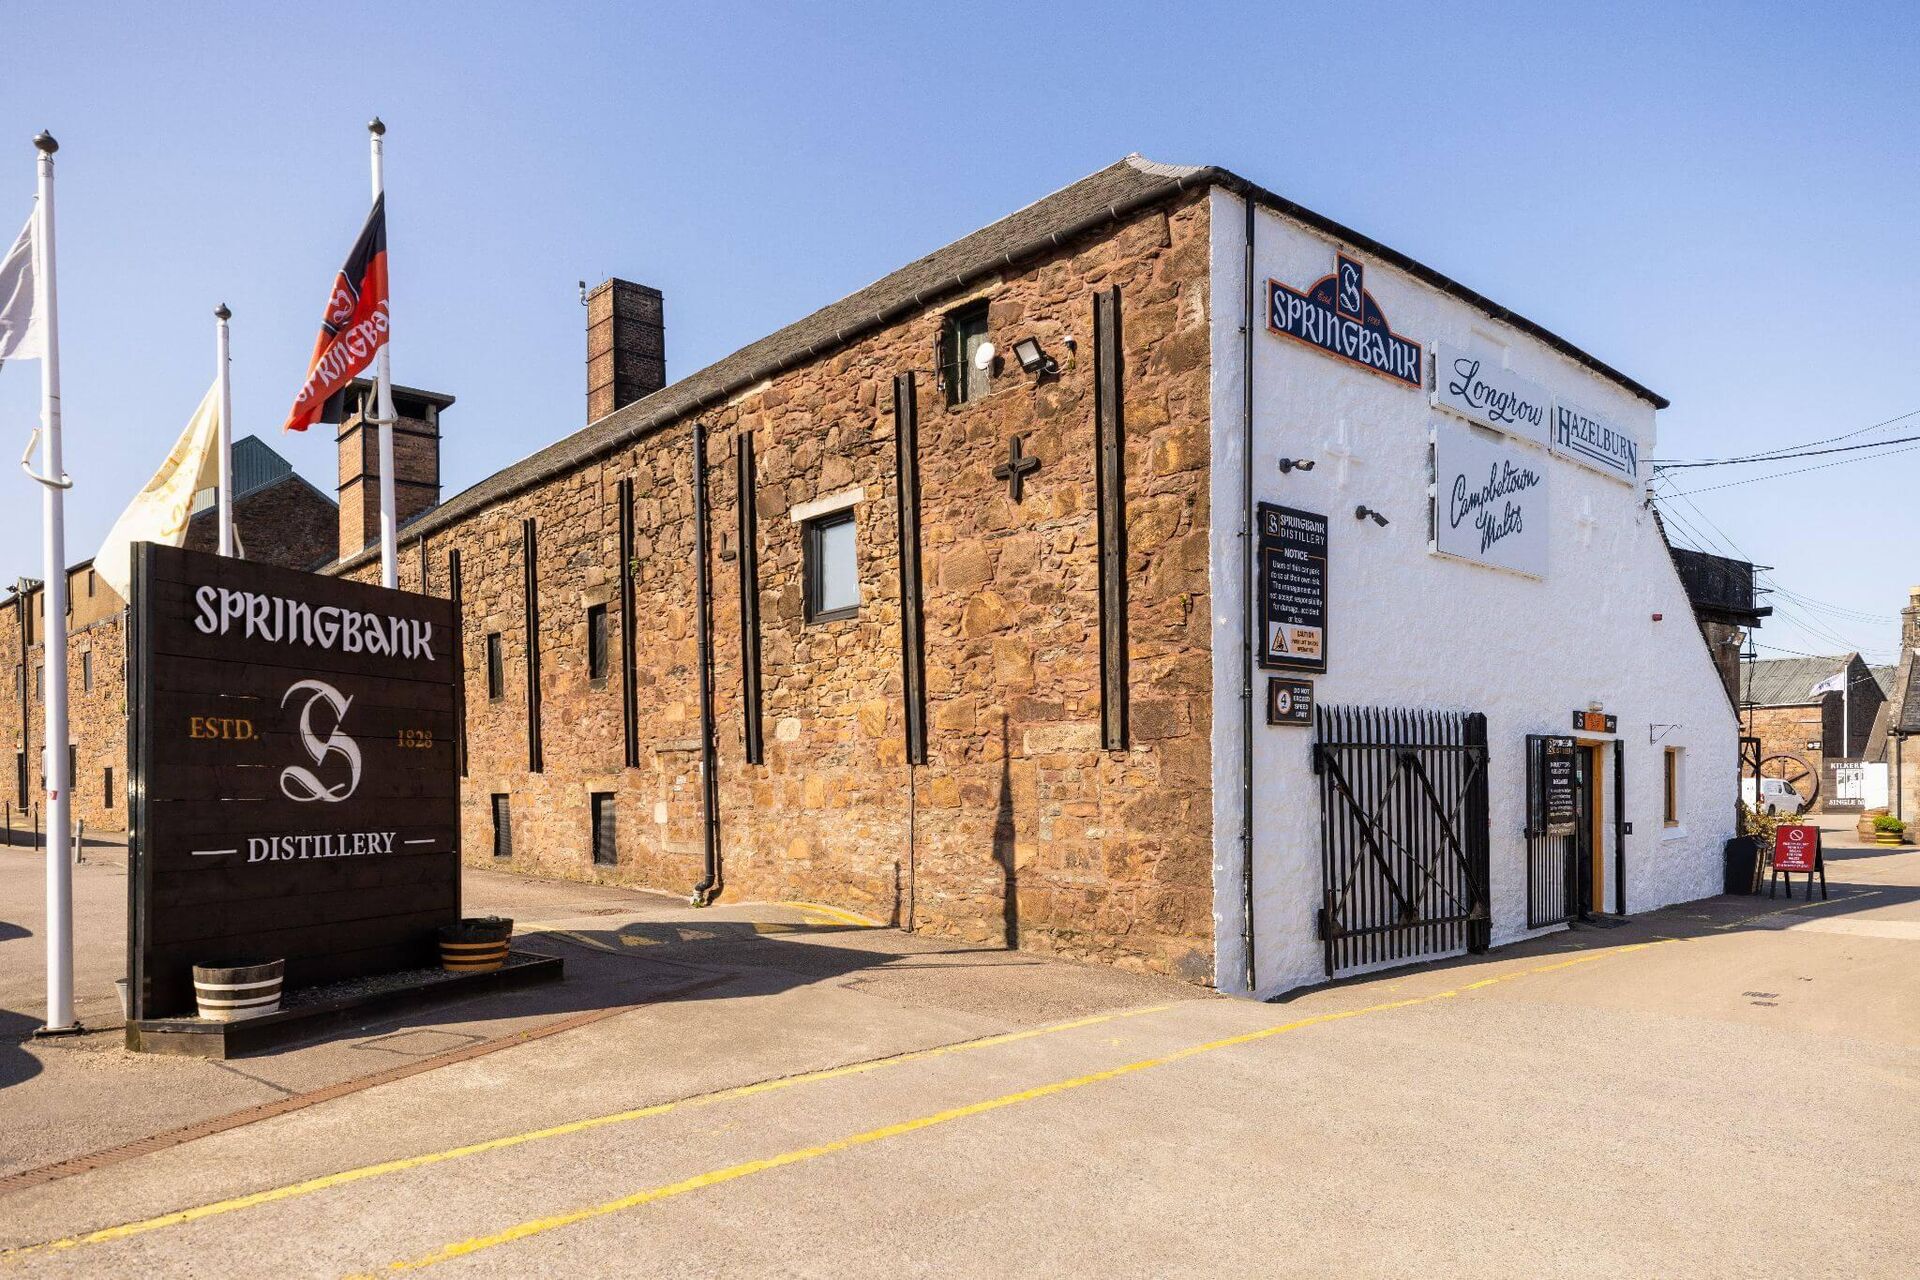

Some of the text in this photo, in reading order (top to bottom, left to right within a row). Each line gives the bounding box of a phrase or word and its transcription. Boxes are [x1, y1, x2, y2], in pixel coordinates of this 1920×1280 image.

[1273, 289, 1418, 383] SPRINGBANK
[1449, 357, 1545, 428] Longrow
[1556, 405, 1637, 475] HAZELBURN
[1449, 460, 1540, 530] Campbeltown
[1475, 500, 1523, 554] Malts
[1280, 527, 1325, 546] DISTILLERY
[1284, 547, 1309, 561] NOTICE
[194, 585, 435, 661] SPRINGBANK
[189, 716, 433, 749] ESTD. 1828
[280, 678, 362, 803] S
[247, 831, 397, 863] DISTILLERY
